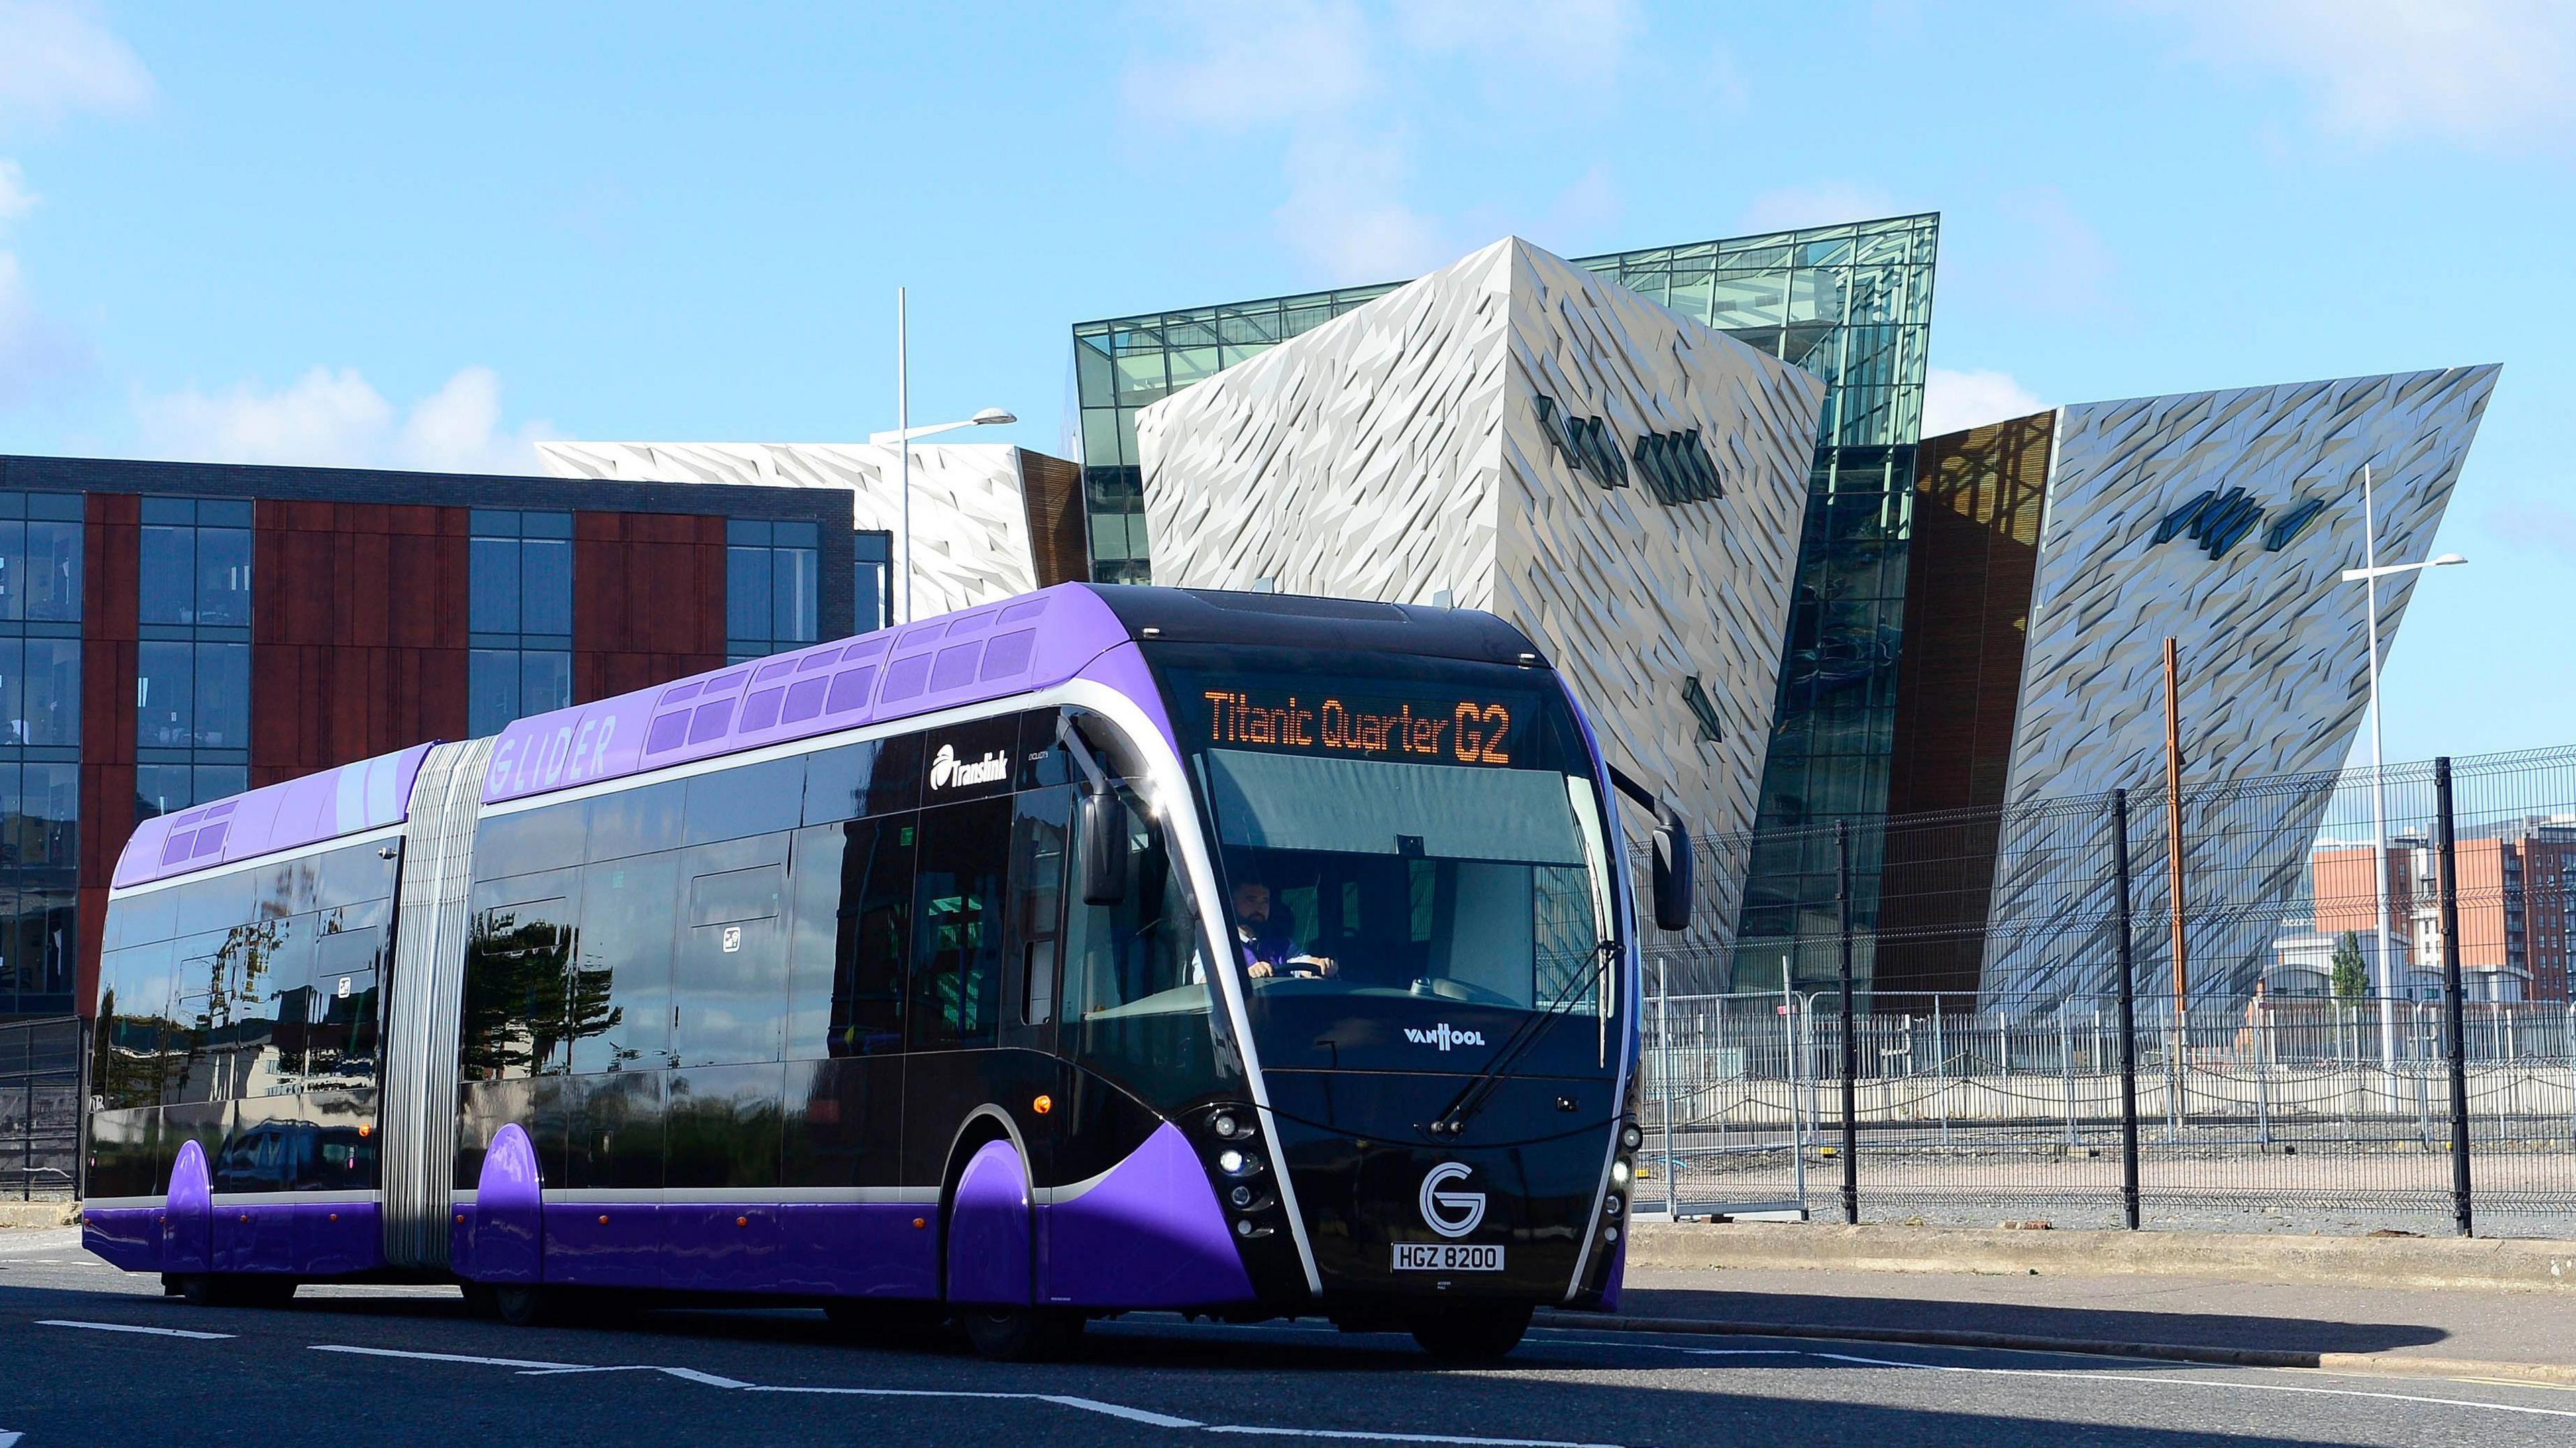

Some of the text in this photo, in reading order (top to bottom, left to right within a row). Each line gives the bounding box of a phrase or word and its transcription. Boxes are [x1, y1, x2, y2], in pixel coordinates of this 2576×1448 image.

[1205, 691, 1508, 763] Titanic Quarter G2
[489, 715, 616, 795] GLIDER
[951, 750, 1008, 787] Translink
[1399, 1247, 1497, 1268] HGZ 8200
